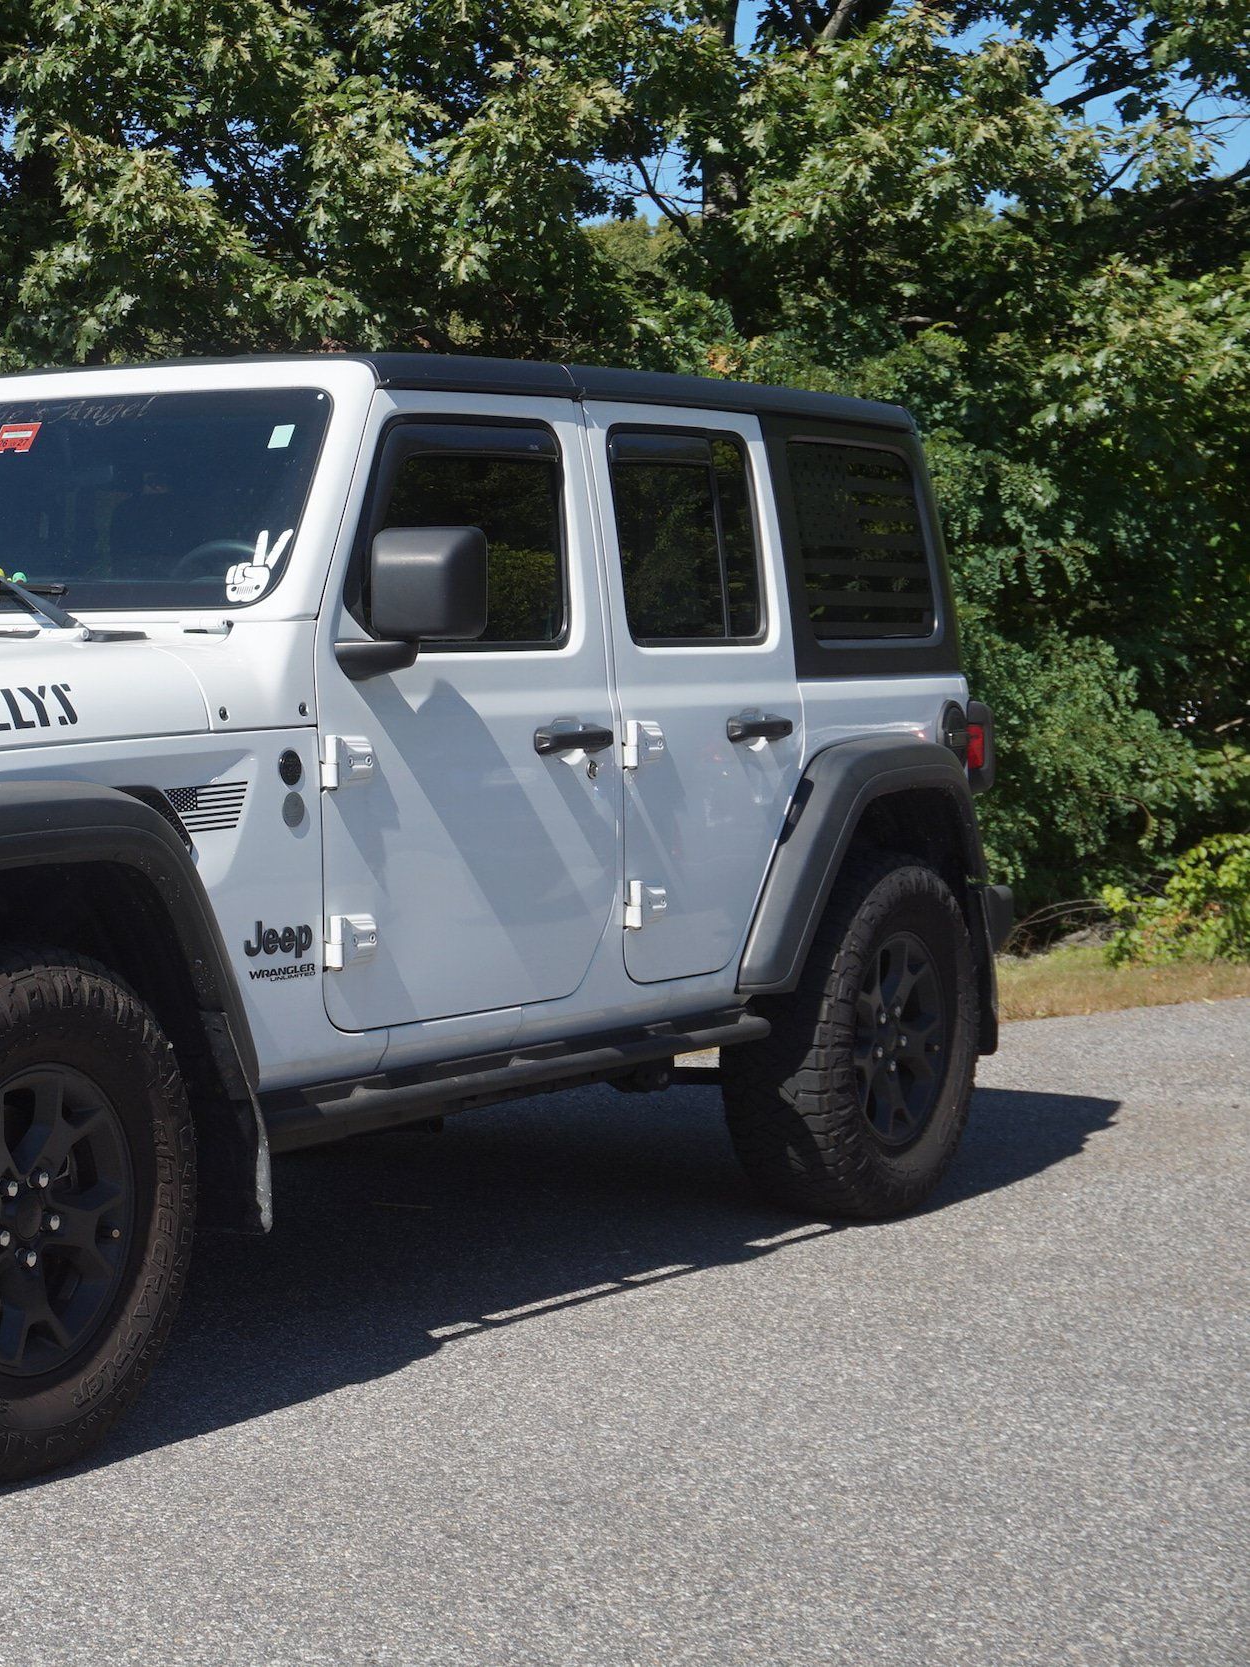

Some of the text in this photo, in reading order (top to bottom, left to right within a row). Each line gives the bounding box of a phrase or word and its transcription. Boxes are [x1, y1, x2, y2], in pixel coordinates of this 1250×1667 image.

[49, 395, 158, 426] Angel
[244, 920, 313, 958] Jeep
[249, 963, 315, 980] WRANGLER
[270, 971, 316, 982] UNLIMITED
